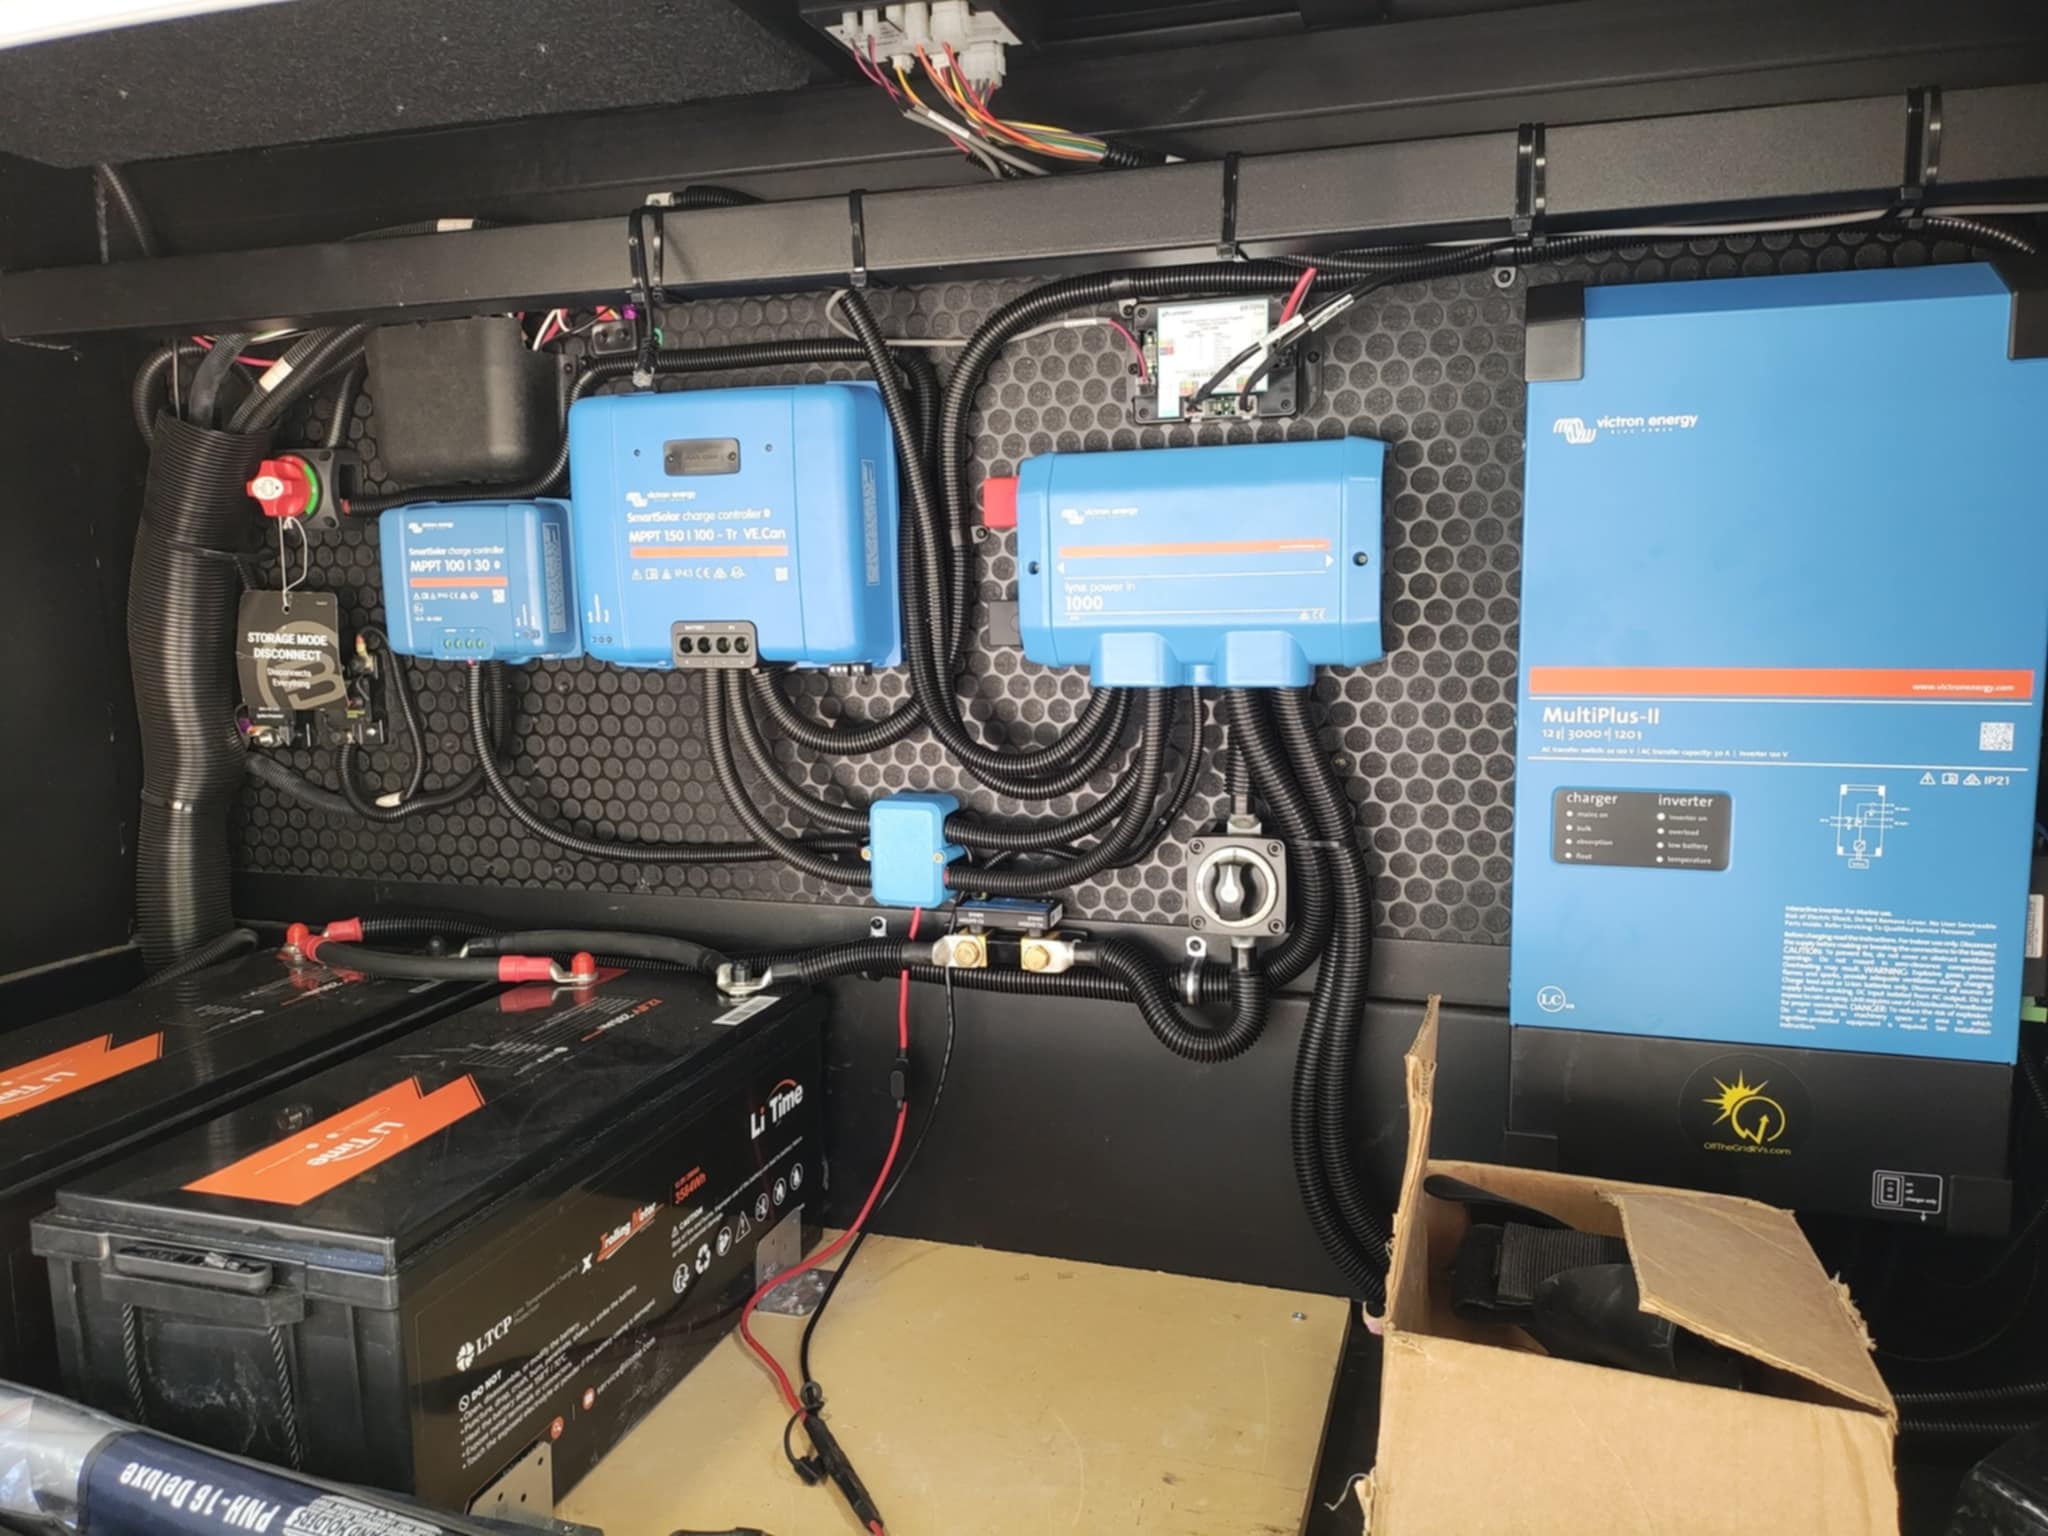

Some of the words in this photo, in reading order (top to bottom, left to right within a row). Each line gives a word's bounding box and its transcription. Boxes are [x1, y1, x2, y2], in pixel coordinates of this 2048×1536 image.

[1597, 416, 1644, 428] victron
[1648, 414, 1699, 428] energy
[627, 512, 680, 522] SmartSolar
[682, 511, 716, 522] charge
[718, 509, 761, 520] controller
[629, 530, 660, 542] MPPT
[664, 530, 683, 542] 150
[694, 530, 714, 541] 100
[726, 528, 737, 540] Tr
[743, 528, 785, 540] VE.Can
[410, 560, 441, 572] MPPT
[444, 560, 465, 572] 100
[474, 559, 490, 571] 30
[1089, 582, 1123, 594] power
[1126, 581, 1136, 592] in
[1065, 595, 1104, 610] 1000
[247, 632, 296, 644] STORAGE
[297, 635, 328, 646] MODE
[253, 648, 322, 662] DISCONNECT
[272, 678, 311, 690] Everything
[1912, 683, 2015, 693] www.victronenergy.com
[1543, 706, 1660, 724] MultiPlus-II
[1984, 775, 2010, 786] IP21
[1566, 792, 1619, 808] charger
[1658, 794, 1713, 808] inverter
[1682, 842, 1709, 851] battery
[1667, 856, 1712, 865] temperature
[751, 1105, 765, 1139] Li
[769, 1083, 804, 1124] Time
[306, 1137, 379, 1167] Time
[1703, 1141, 1792, 1156] OffTheGridRVs.com
[476, 1315, 512, 1356] LTCP
[471, 1385, 485, 1402] DO
[485, 1368, 503, 1390] NOT
[118, 1461, 197, 1509] Deluxe
[188, 1484, 282, 1533] PNH-16
